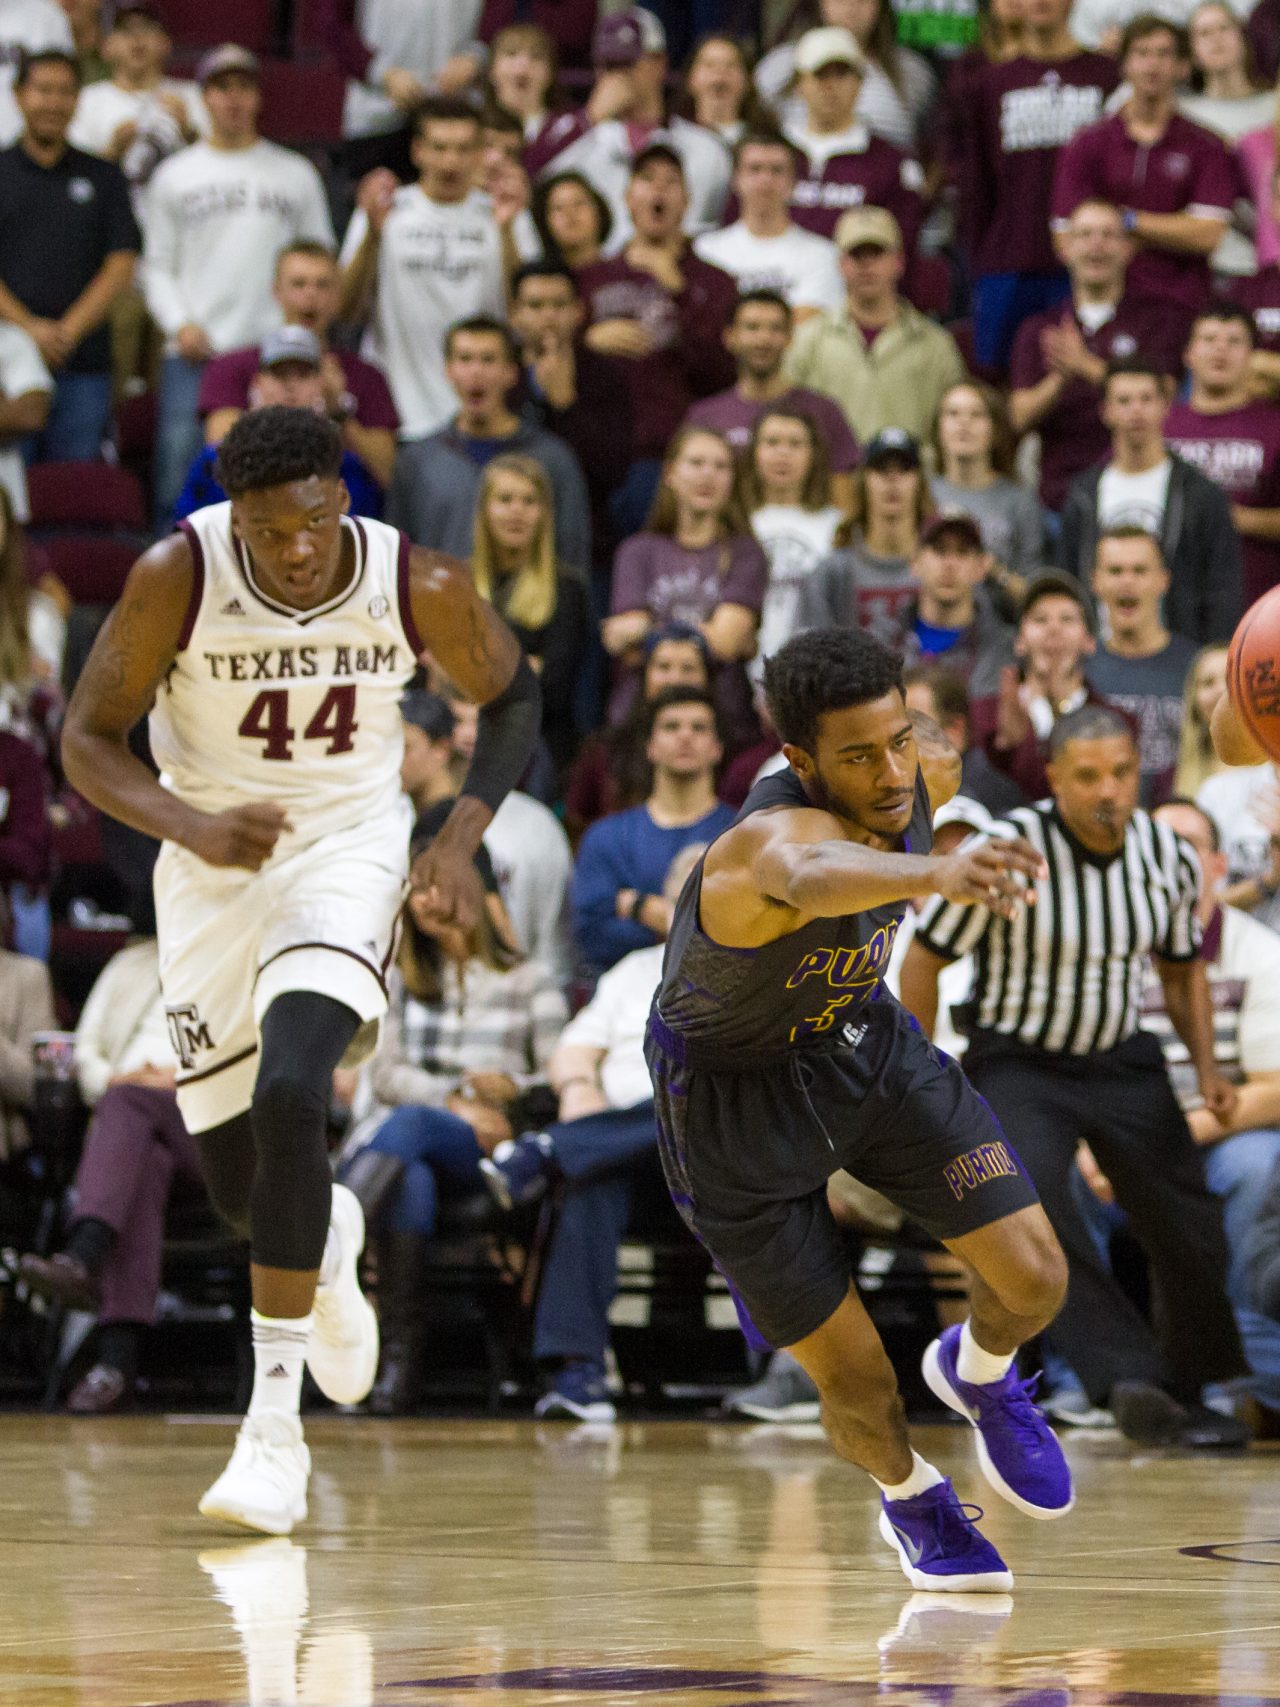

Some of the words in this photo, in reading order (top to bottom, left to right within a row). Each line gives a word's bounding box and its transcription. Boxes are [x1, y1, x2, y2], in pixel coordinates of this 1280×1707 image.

[203, 646, 319, 681] TEXAS
[333, 643, 399, 676] A&M
[237, 683, 360, 762] 44
